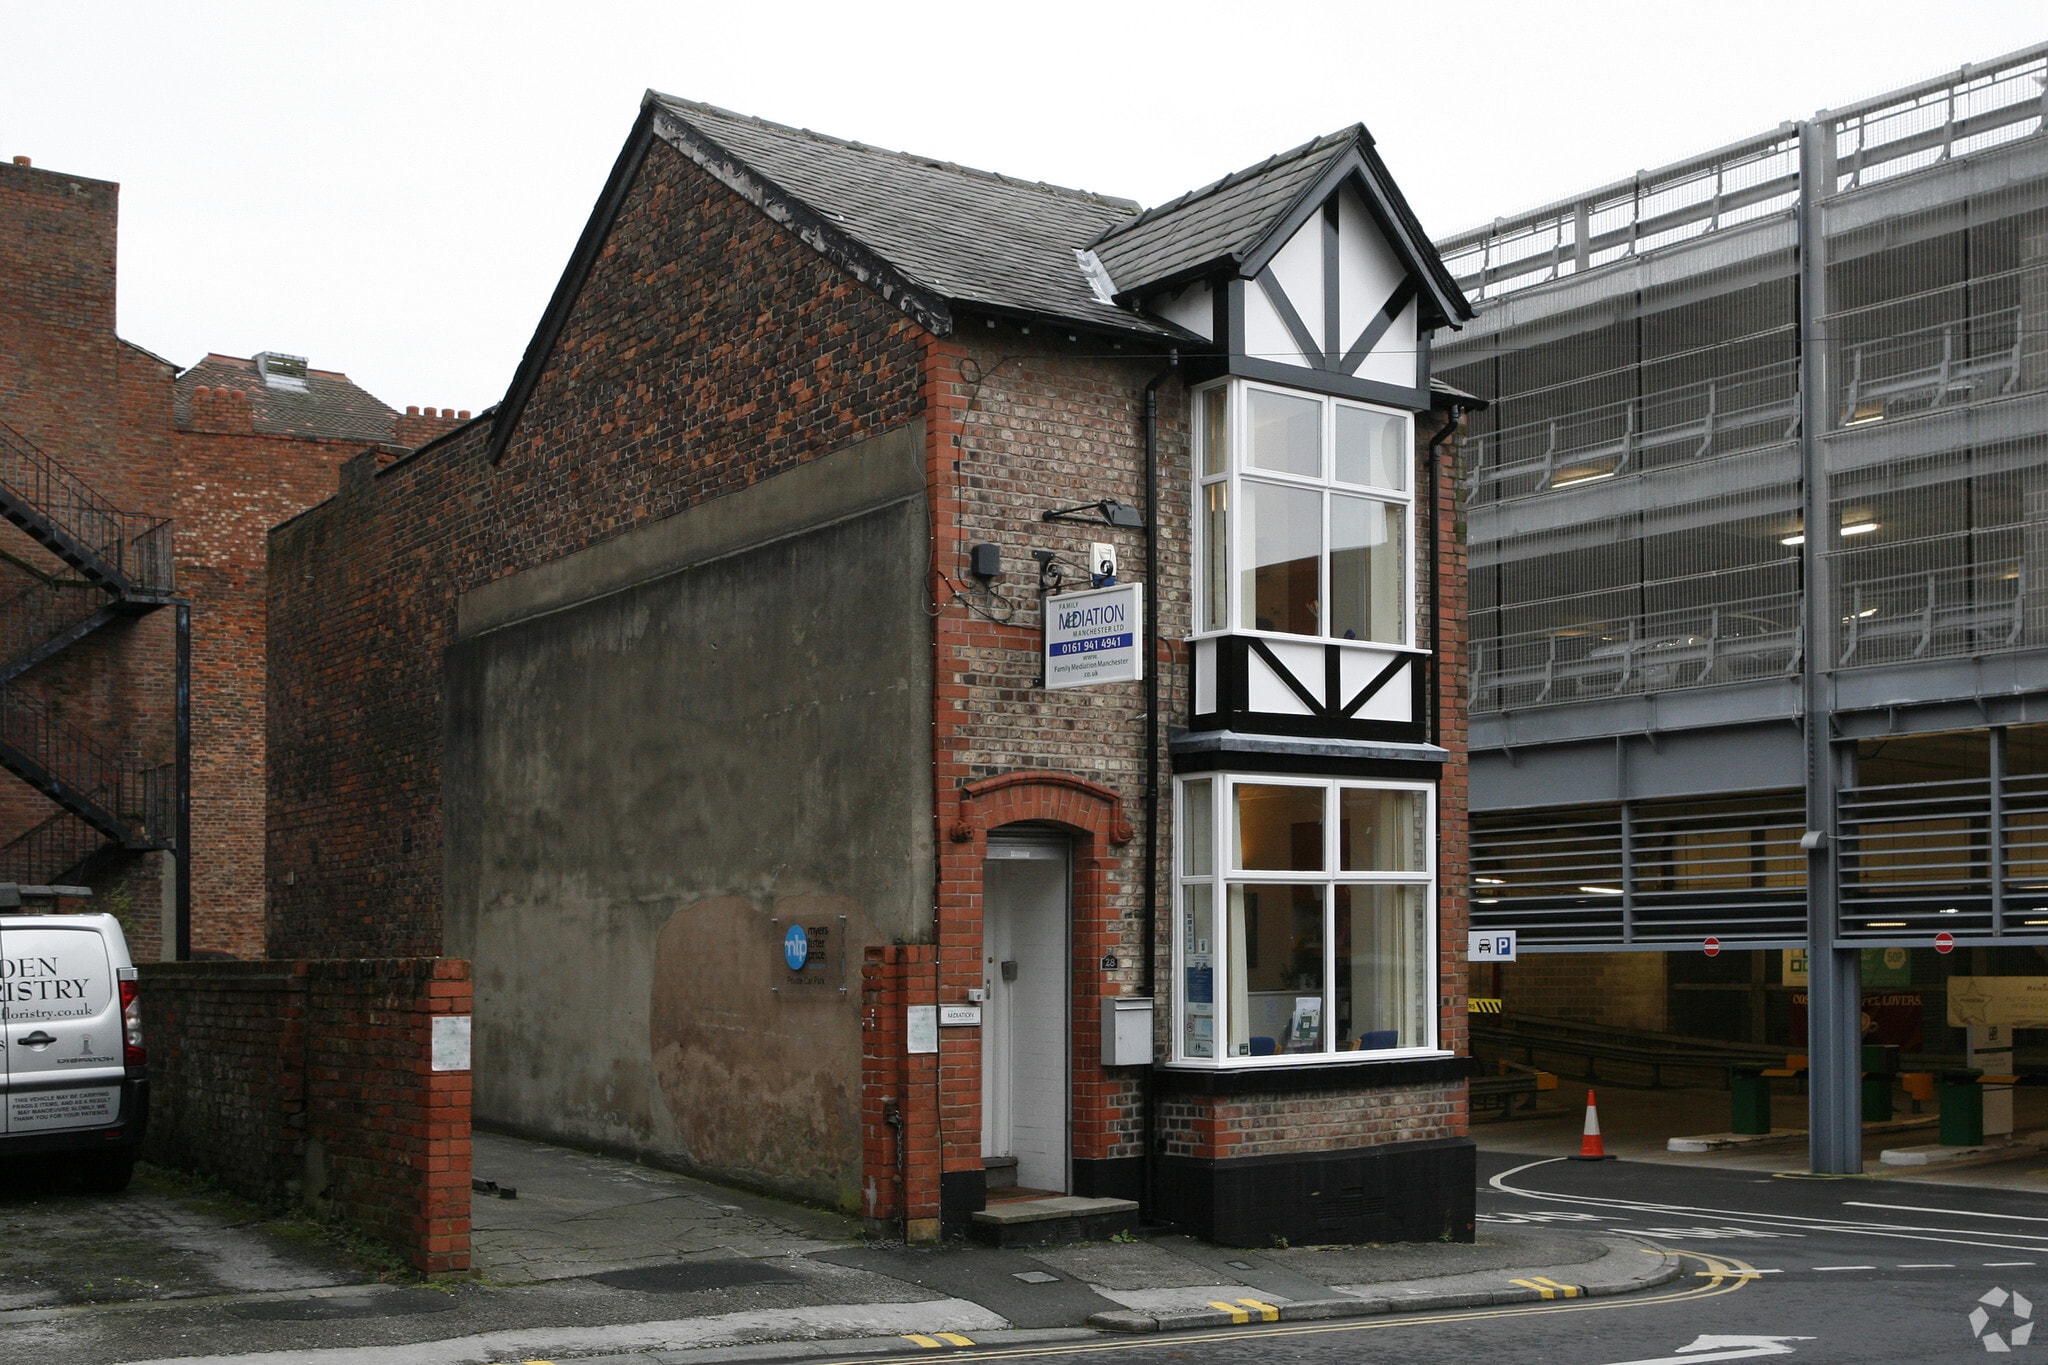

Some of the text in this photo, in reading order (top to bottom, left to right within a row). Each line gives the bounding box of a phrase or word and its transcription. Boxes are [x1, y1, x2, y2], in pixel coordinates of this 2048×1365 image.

[1059, 602, 1079, 610] FAMILY
[1073, 624, 1124, 637] MANCHESTER LTD
[1062, 636, 1120, 653] 0161 941 4941
[784, 934, 807, 962] mlp
[1105, 958, 1116, 967] 28
[0, 979, 90, 1003] ISTRY
[57, 1056, 114, 1064] DISPATCH
